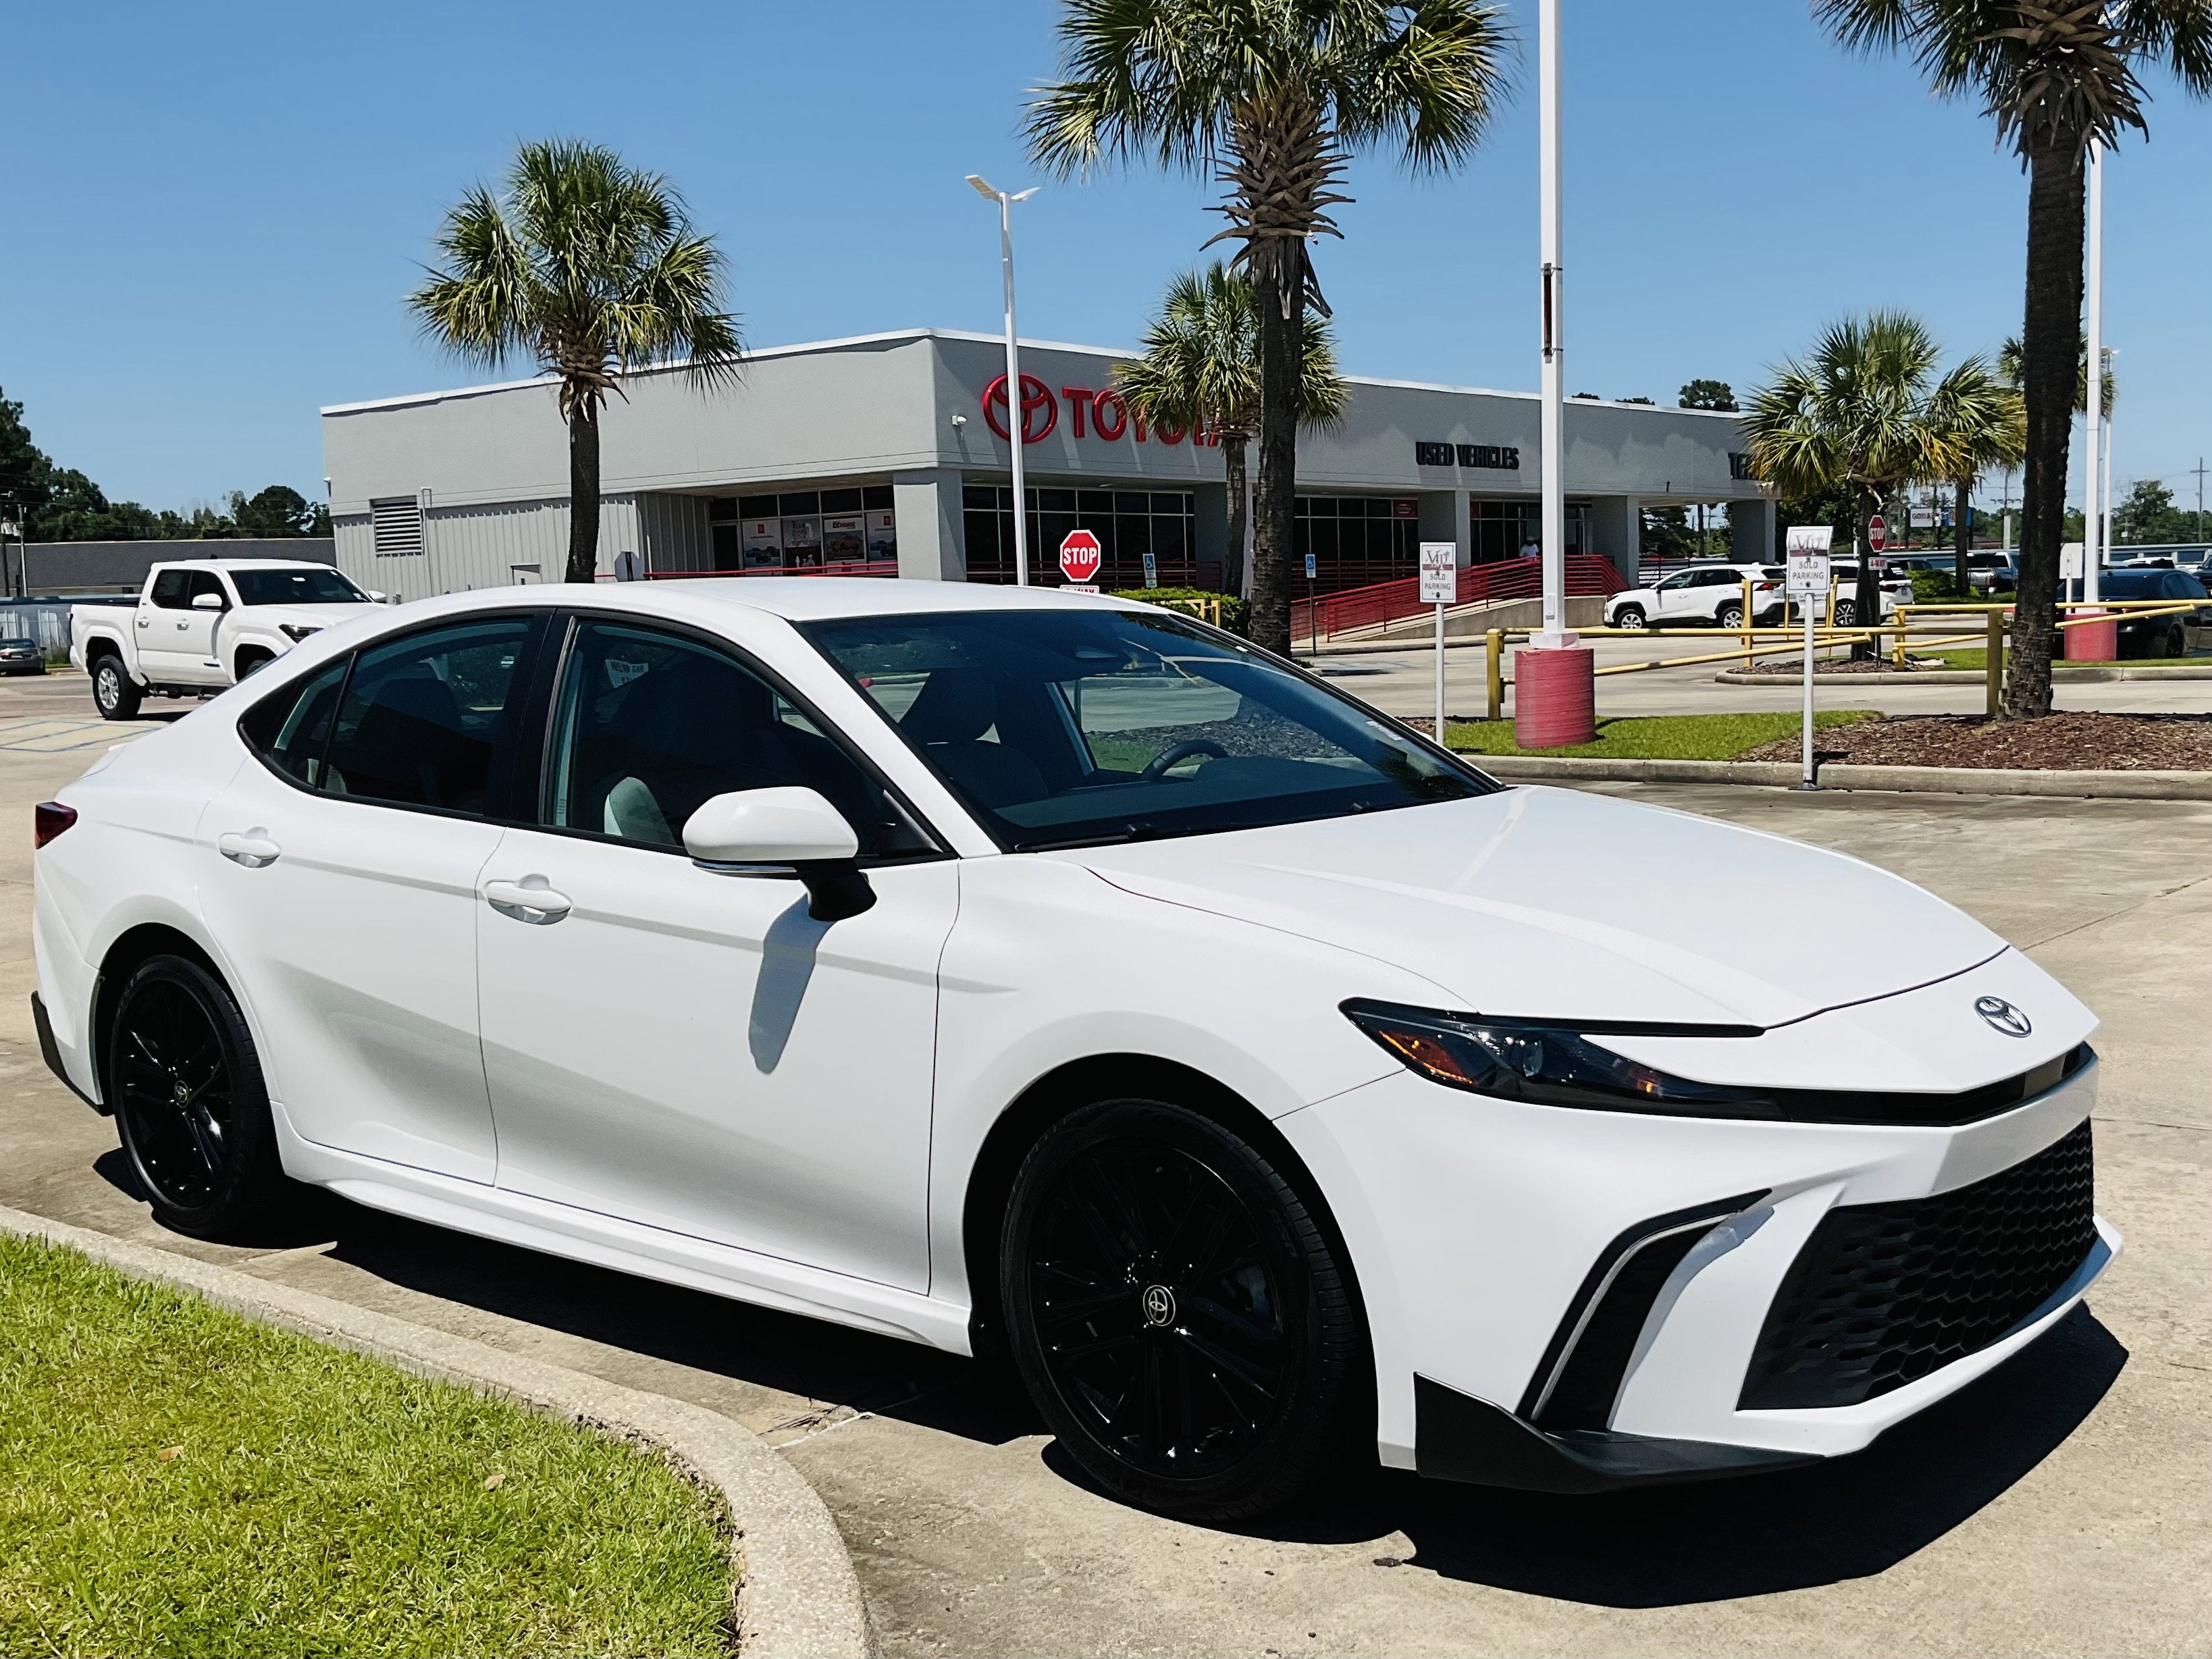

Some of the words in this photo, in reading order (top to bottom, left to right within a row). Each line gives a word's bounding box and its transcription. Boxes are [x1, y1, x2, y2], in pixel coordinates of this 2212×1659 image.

[1415, 442, 1454, 466] USED
[1456, 444, 1519, 469] VEHICLES
[1870, 527, 1885, 540] STOP
[1063, 547, 1097, 564] STOP
